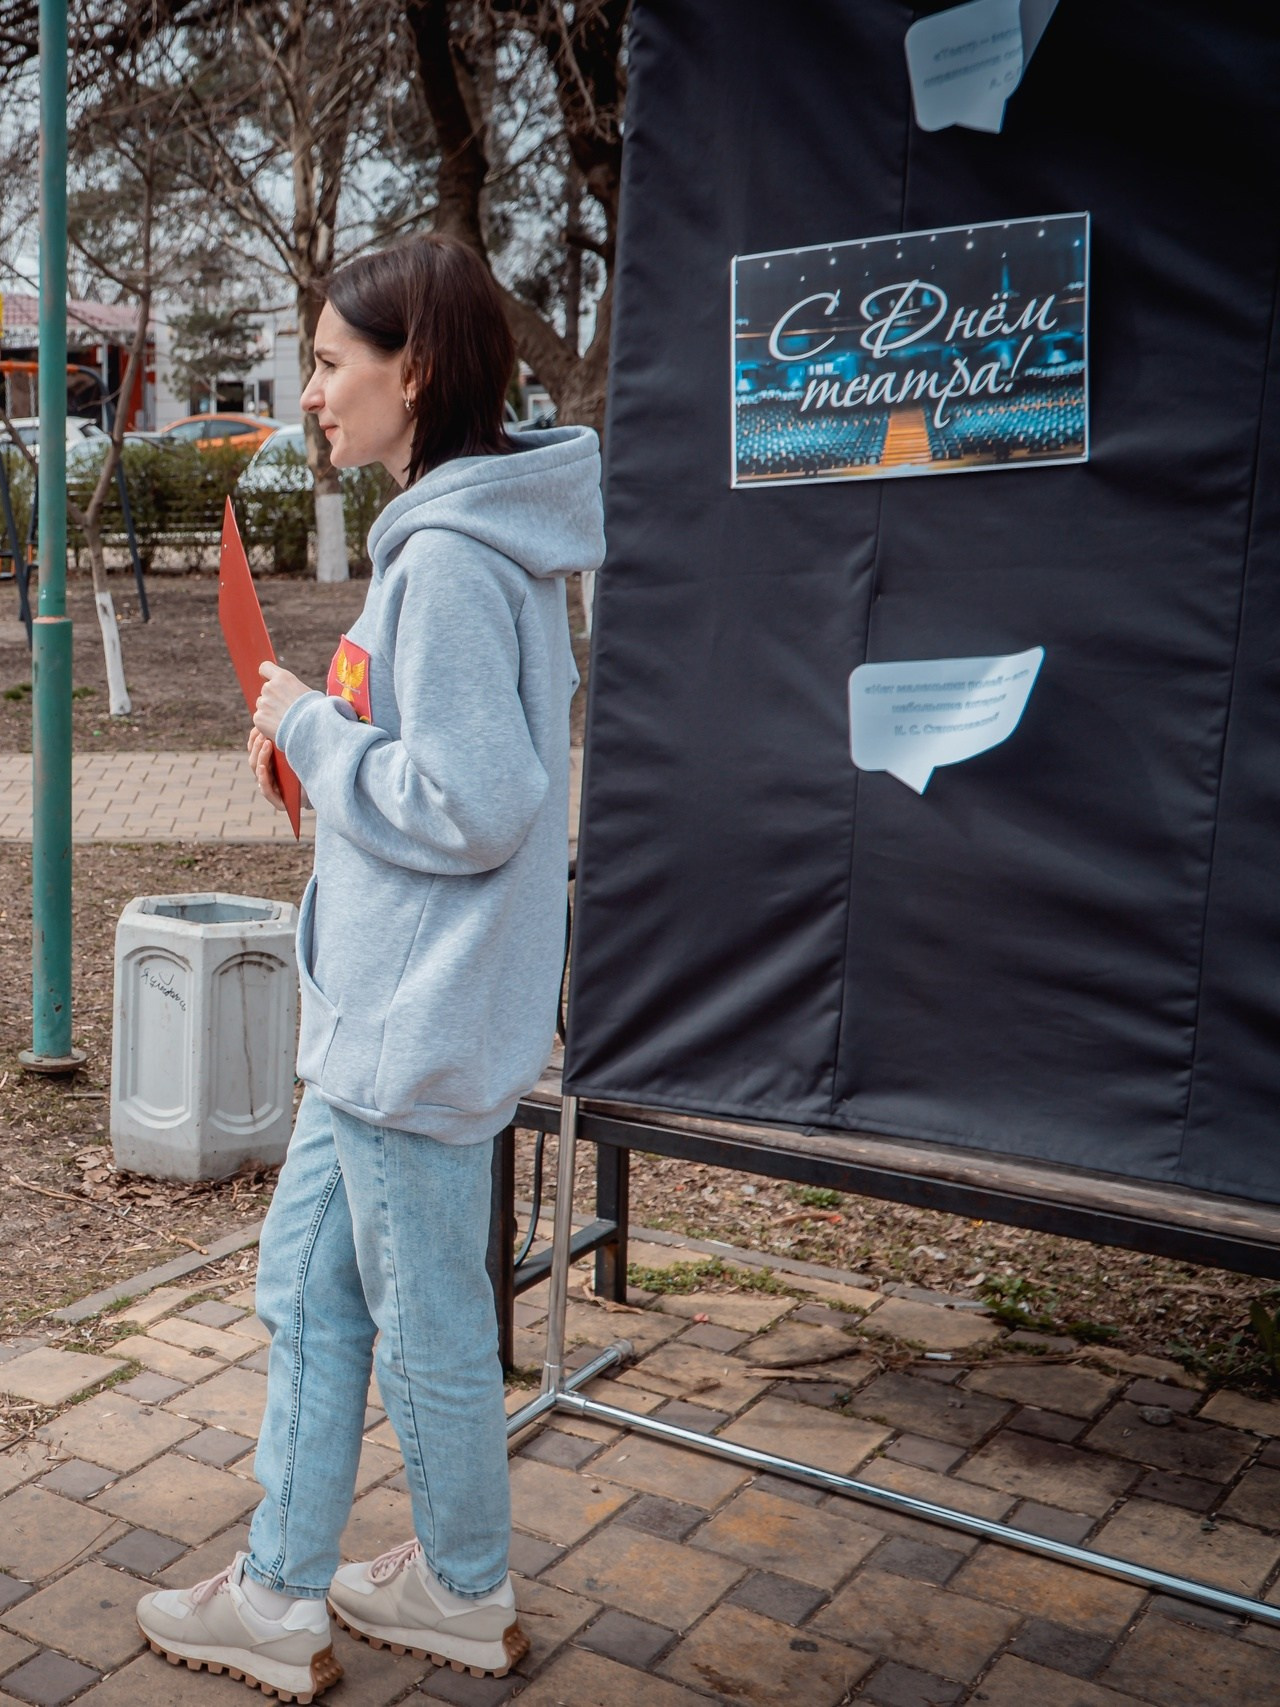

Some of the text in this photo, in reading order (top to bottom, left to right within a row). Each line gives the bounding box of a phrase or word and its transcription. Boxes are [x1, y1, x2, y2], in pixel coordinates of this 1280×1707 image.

[769, 279, 1057, 361] С Днём
[799, 334, 1033, 429] театра!
